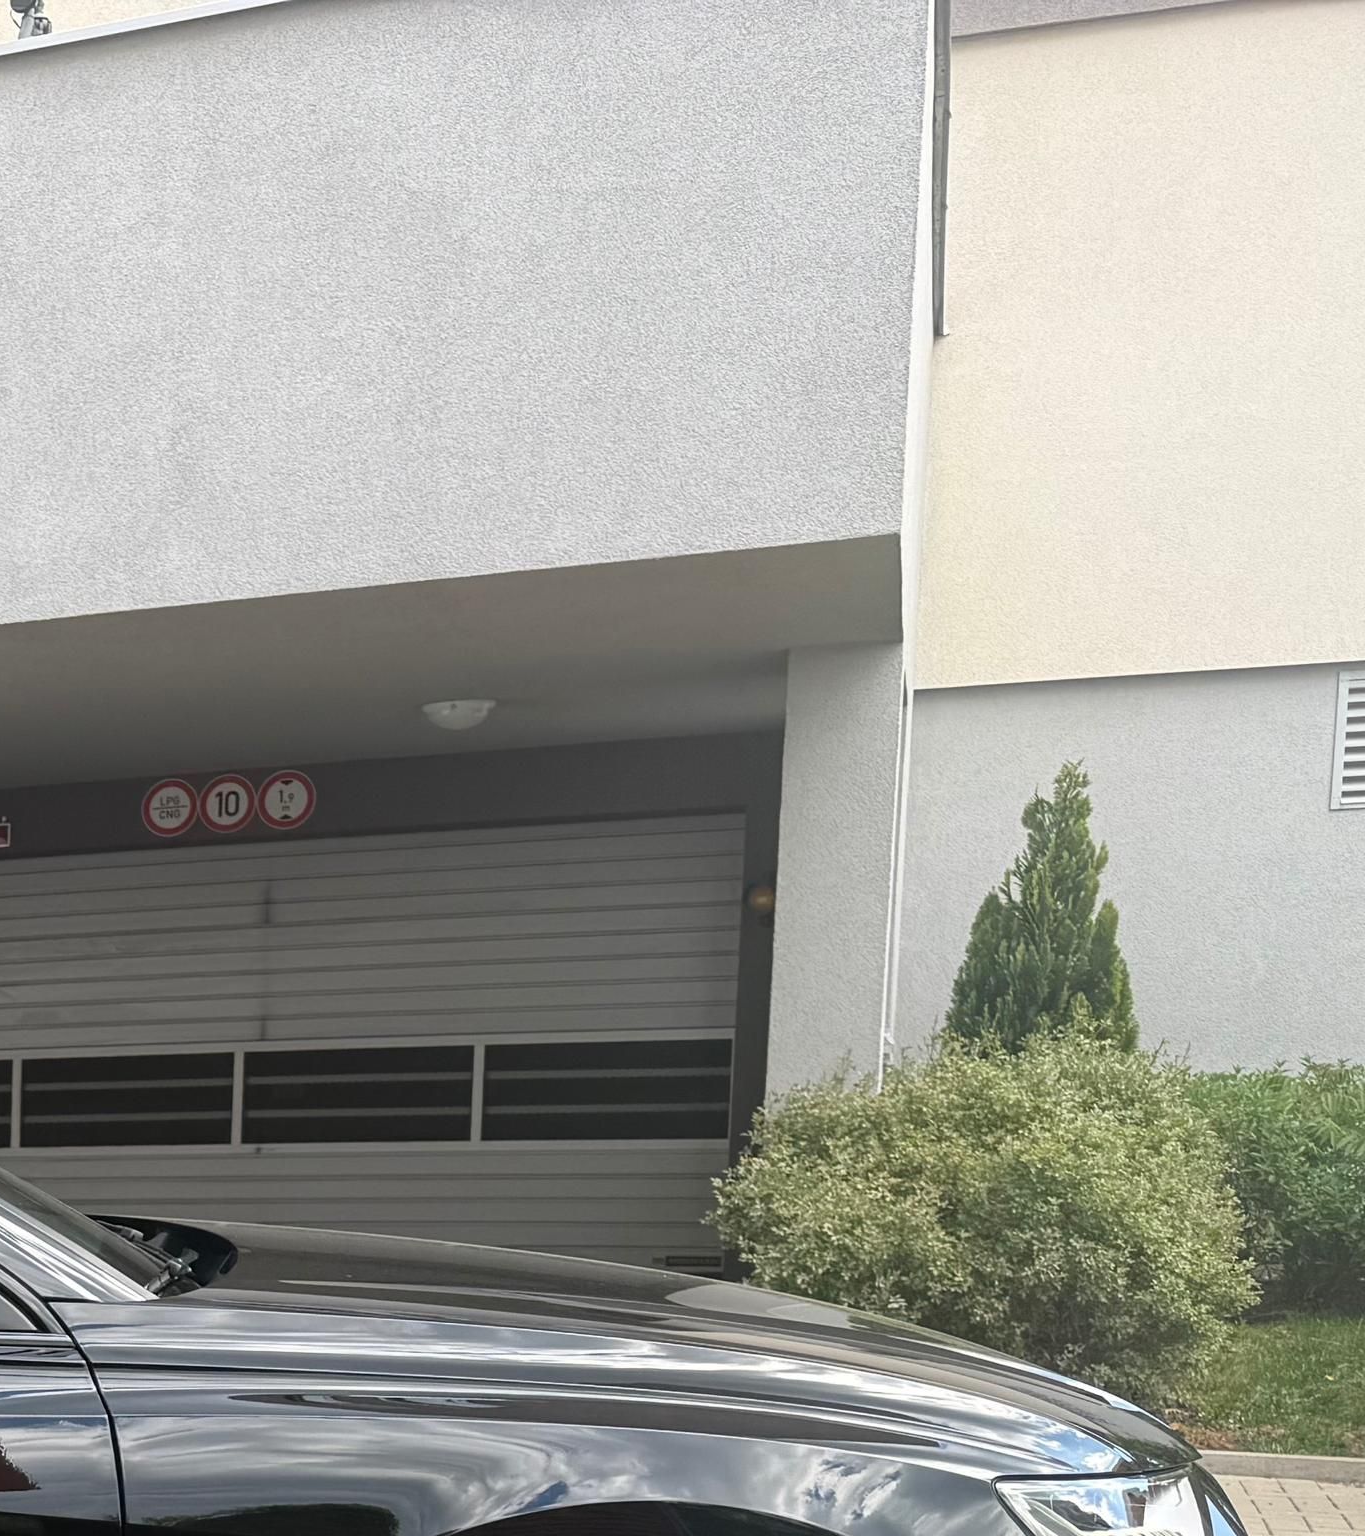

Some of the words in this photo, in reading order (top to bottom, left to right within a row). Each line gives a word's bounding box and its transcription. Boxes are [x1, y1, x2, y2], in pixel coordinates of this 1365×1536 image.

[159, 796, 181, 807] LPG
[215, 791, 240, 818] 10
[159, 809, 181, 820] CNG
